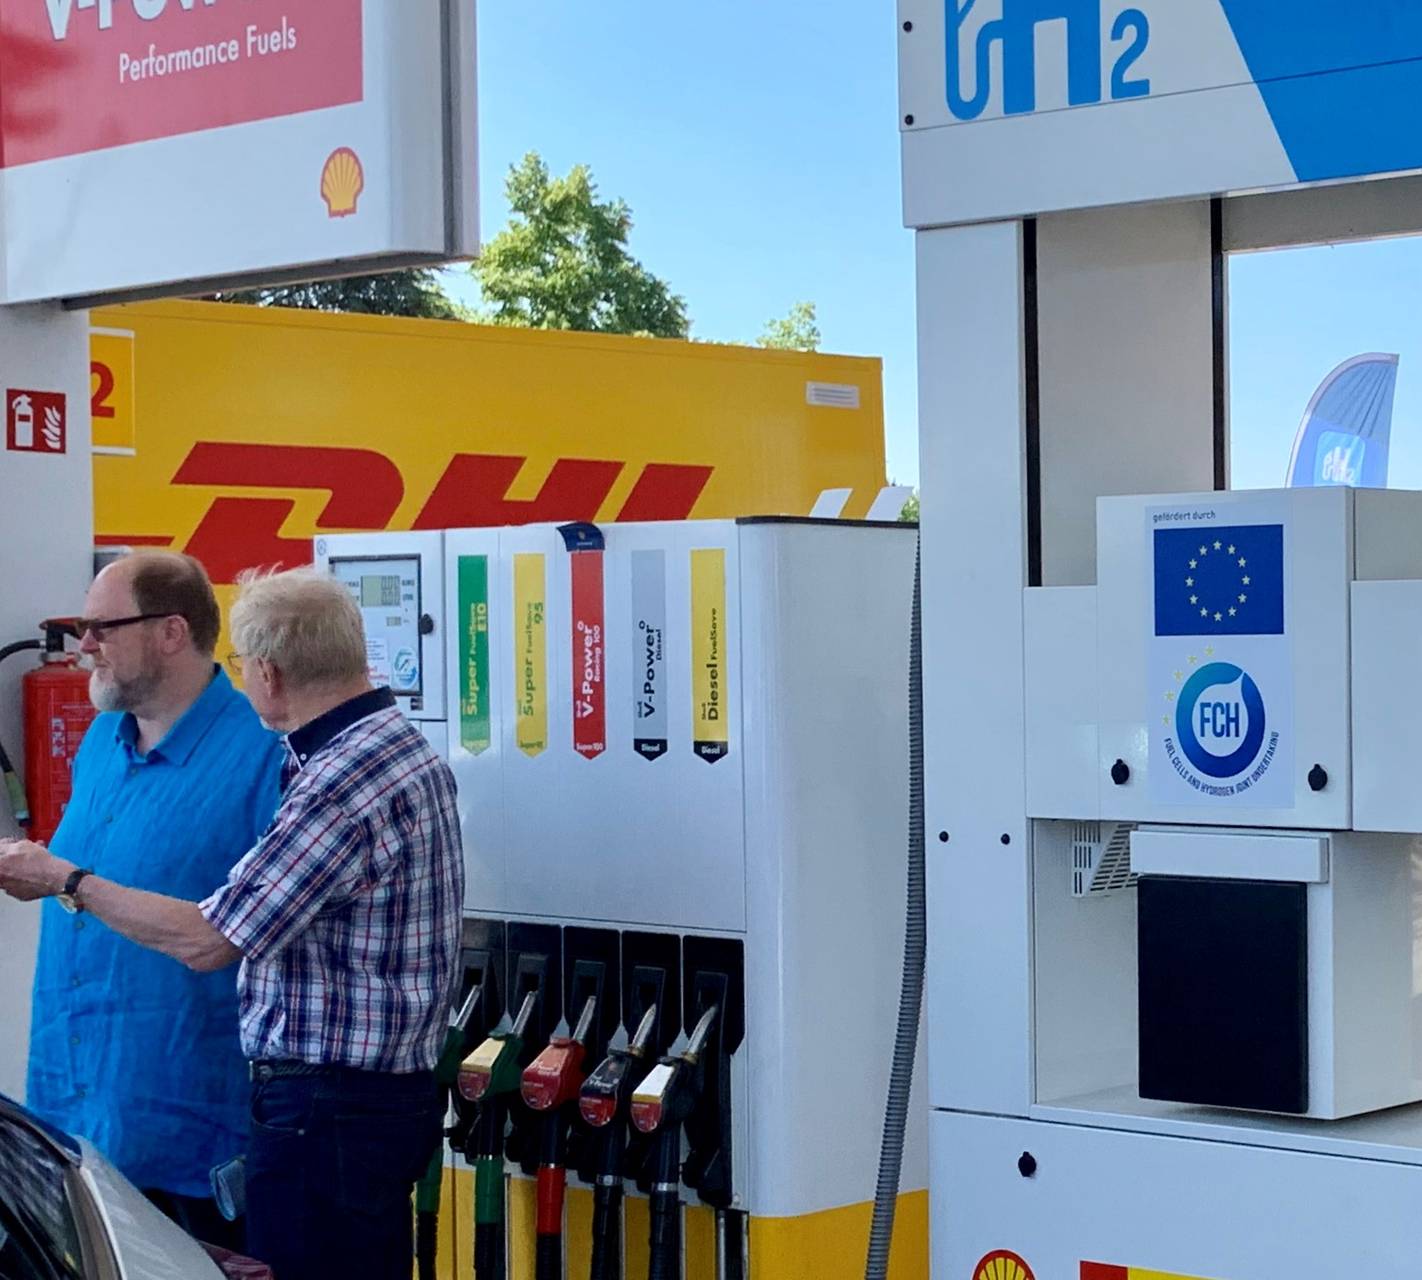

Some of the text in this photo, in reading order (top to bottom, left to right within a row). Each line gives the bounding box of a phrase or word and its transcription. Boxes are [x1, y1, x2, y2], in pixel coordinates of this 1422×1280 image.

[119, 40, 239, 84] Performance
[246, 16, 297, 58] Fuels
[90, 361, 116, 419] 2
[1192, 510, 1216, 520] durch
[534, 602, 545, 624] 95
[465, 658, 478, 716] Super
[523, 660, 537, 716] Super
[582, 626, 594, 718] V-Power
[643, 625, 656, 718] V-Power
[706, 663, 719, 721] Diesel
[1199, 702, 1240, 739] FCH
[1172, 756, 1189, 780] CELLS
